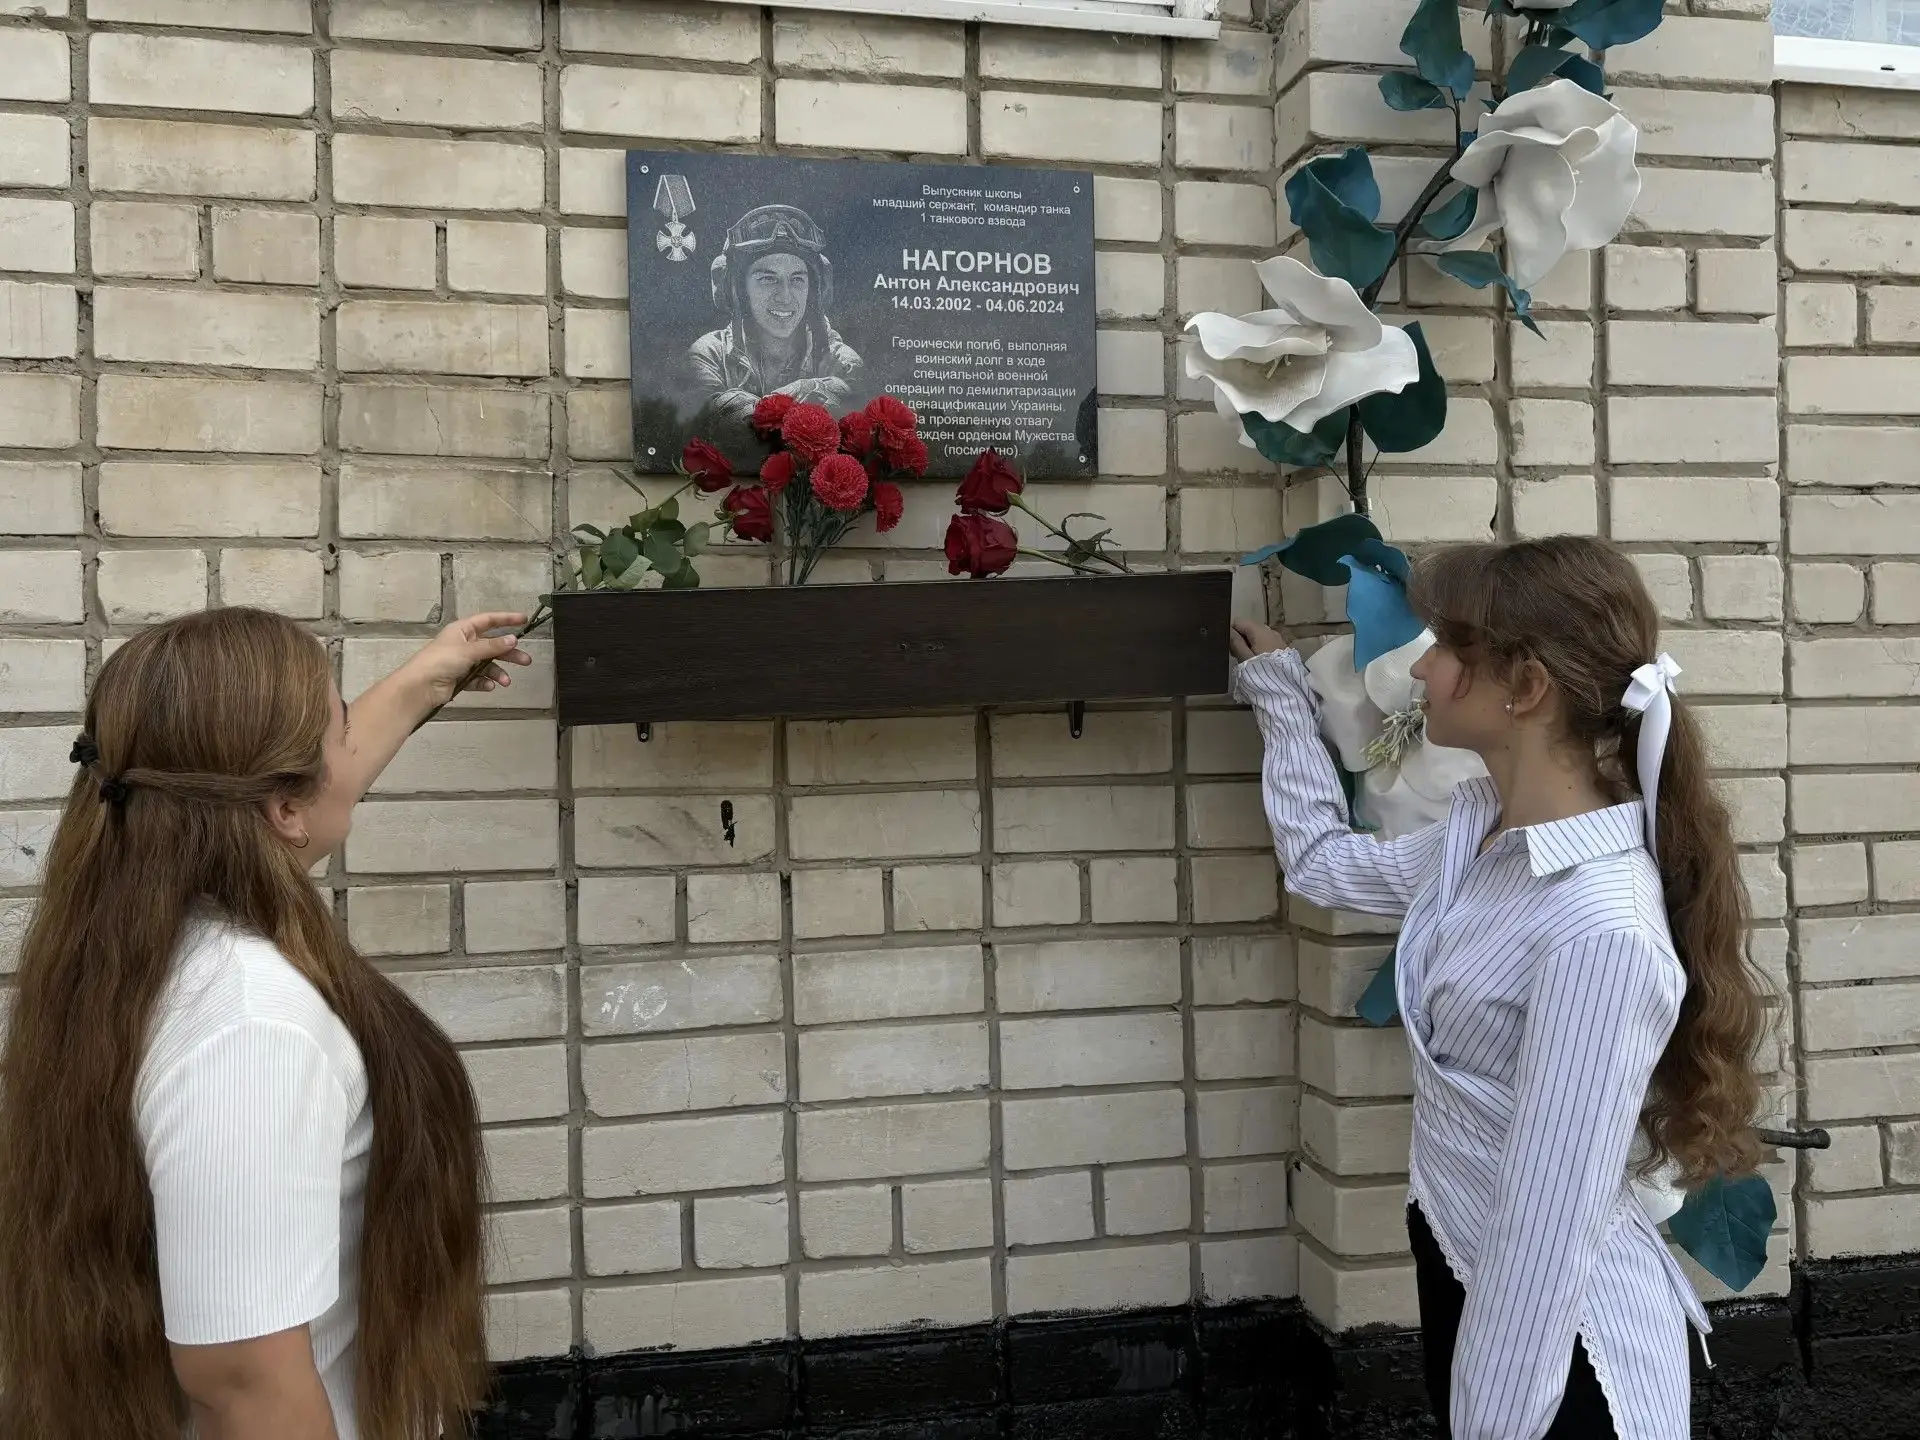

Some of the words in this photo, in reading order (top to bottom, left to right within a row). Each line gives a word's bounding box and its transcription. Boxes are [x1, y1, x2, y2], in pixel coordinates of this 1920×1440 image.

[922, 185, 981, 198] Выпускник
[985, 190, 1021, 198] школы
[873, 198, 925, 209] младший
[929, 201, 977, 212] сержант,
[984, 204, 1037, 215] командир
[1040, 205, 1071, 214] танка
[921, 213, 926, 222] 1
[930, 215, 985, 225] танкового
[988, 217, 1026, 227] взвода
[903, 249, 1052, 275] НАГОРНОВ
[874, 274, 931, 290] Антон
[936, 276, 1079, 296] Александрович
[892, 296, 971, 311] 14.03.2002
[986, 299, 1064, 313] 04.06.2024
[892, 337, 963, 350] Героически
[967, 339, 1004, 352] погиб,
[1008, 342, 1067, 352] выполняя
[916, 353, 972, 365] воинский
[975, 356, 1002, 366] долг
[1017, 357, 1045, 367] ходе
[914, 369, 994, 380] специальной
[998, 370, 1048, 380] военной
[885, 384, 944, 395] операции
[949, 386, 963, 395] по
[966, 386, 1076, 398] демилитаризации
[908, 400, 1007, 411] денацификации
[1011, 400, 1066, 412] Украины.
[930, 416, 1011, 426] проявленную
[1015, 417, 1053, 427] отвагу
[916, 431, 955, 441] ажден
[959, 431, 1011, 442] орденом
[1015, 430, 1074, 442] Мужества
